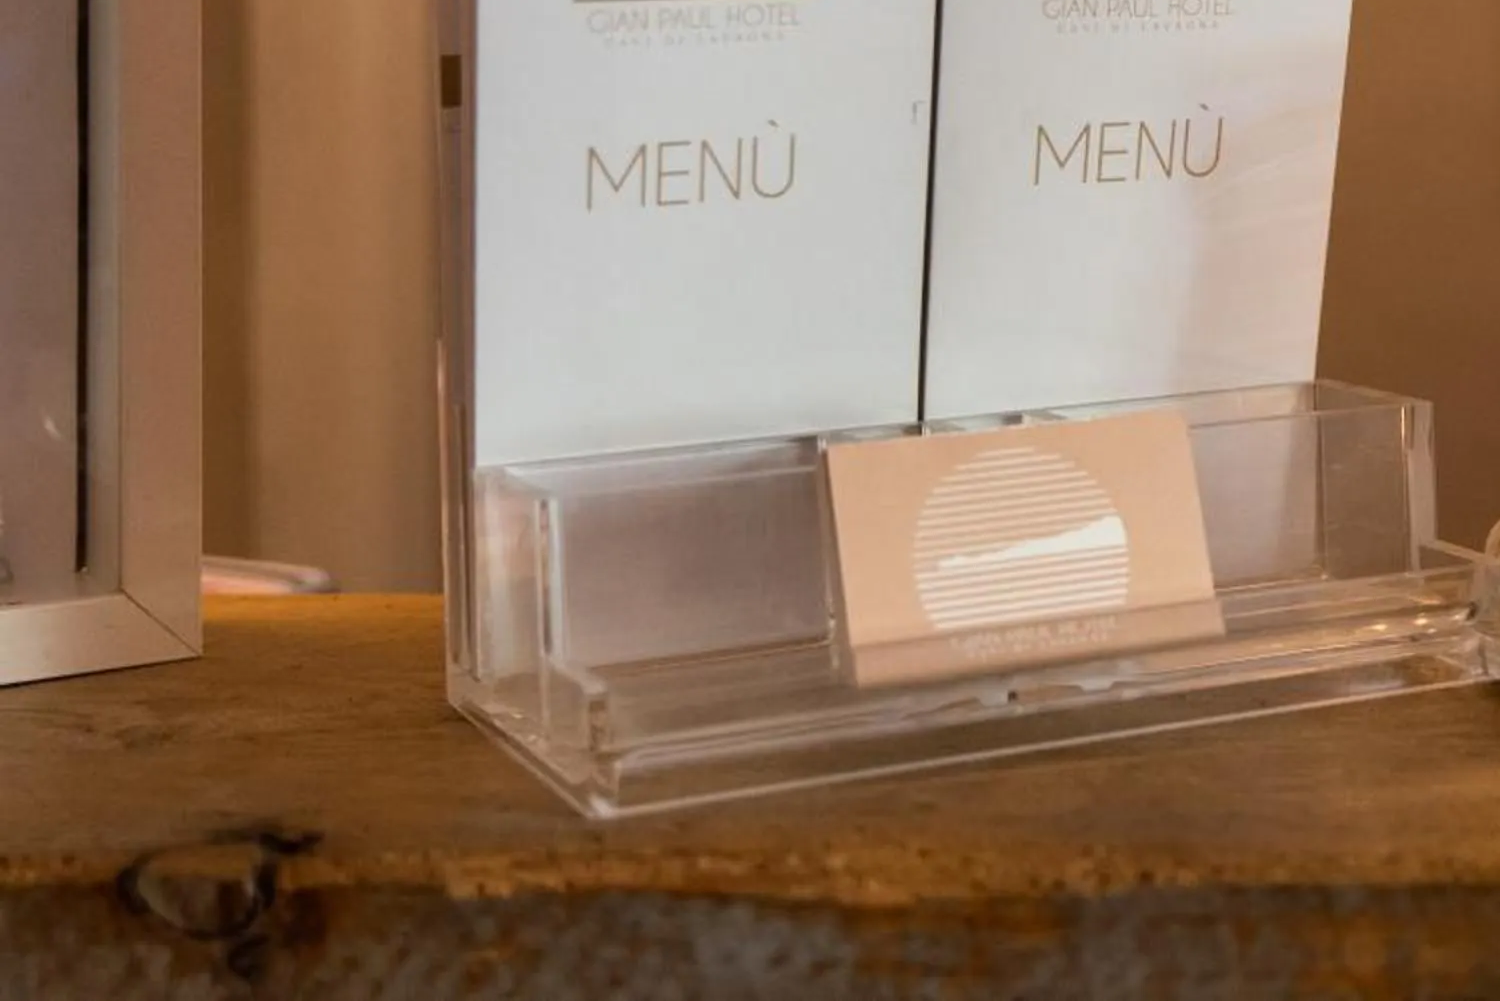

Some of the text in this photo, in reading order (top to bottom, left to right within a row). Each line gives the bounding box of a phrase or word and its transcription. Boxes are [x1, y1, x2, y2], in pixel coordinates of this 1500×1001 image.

[725, 0, 803, 29] HOTEL
[586, 118, 797, 210] MENÙ
[1034, 102, 1224, 186] MENÙ
